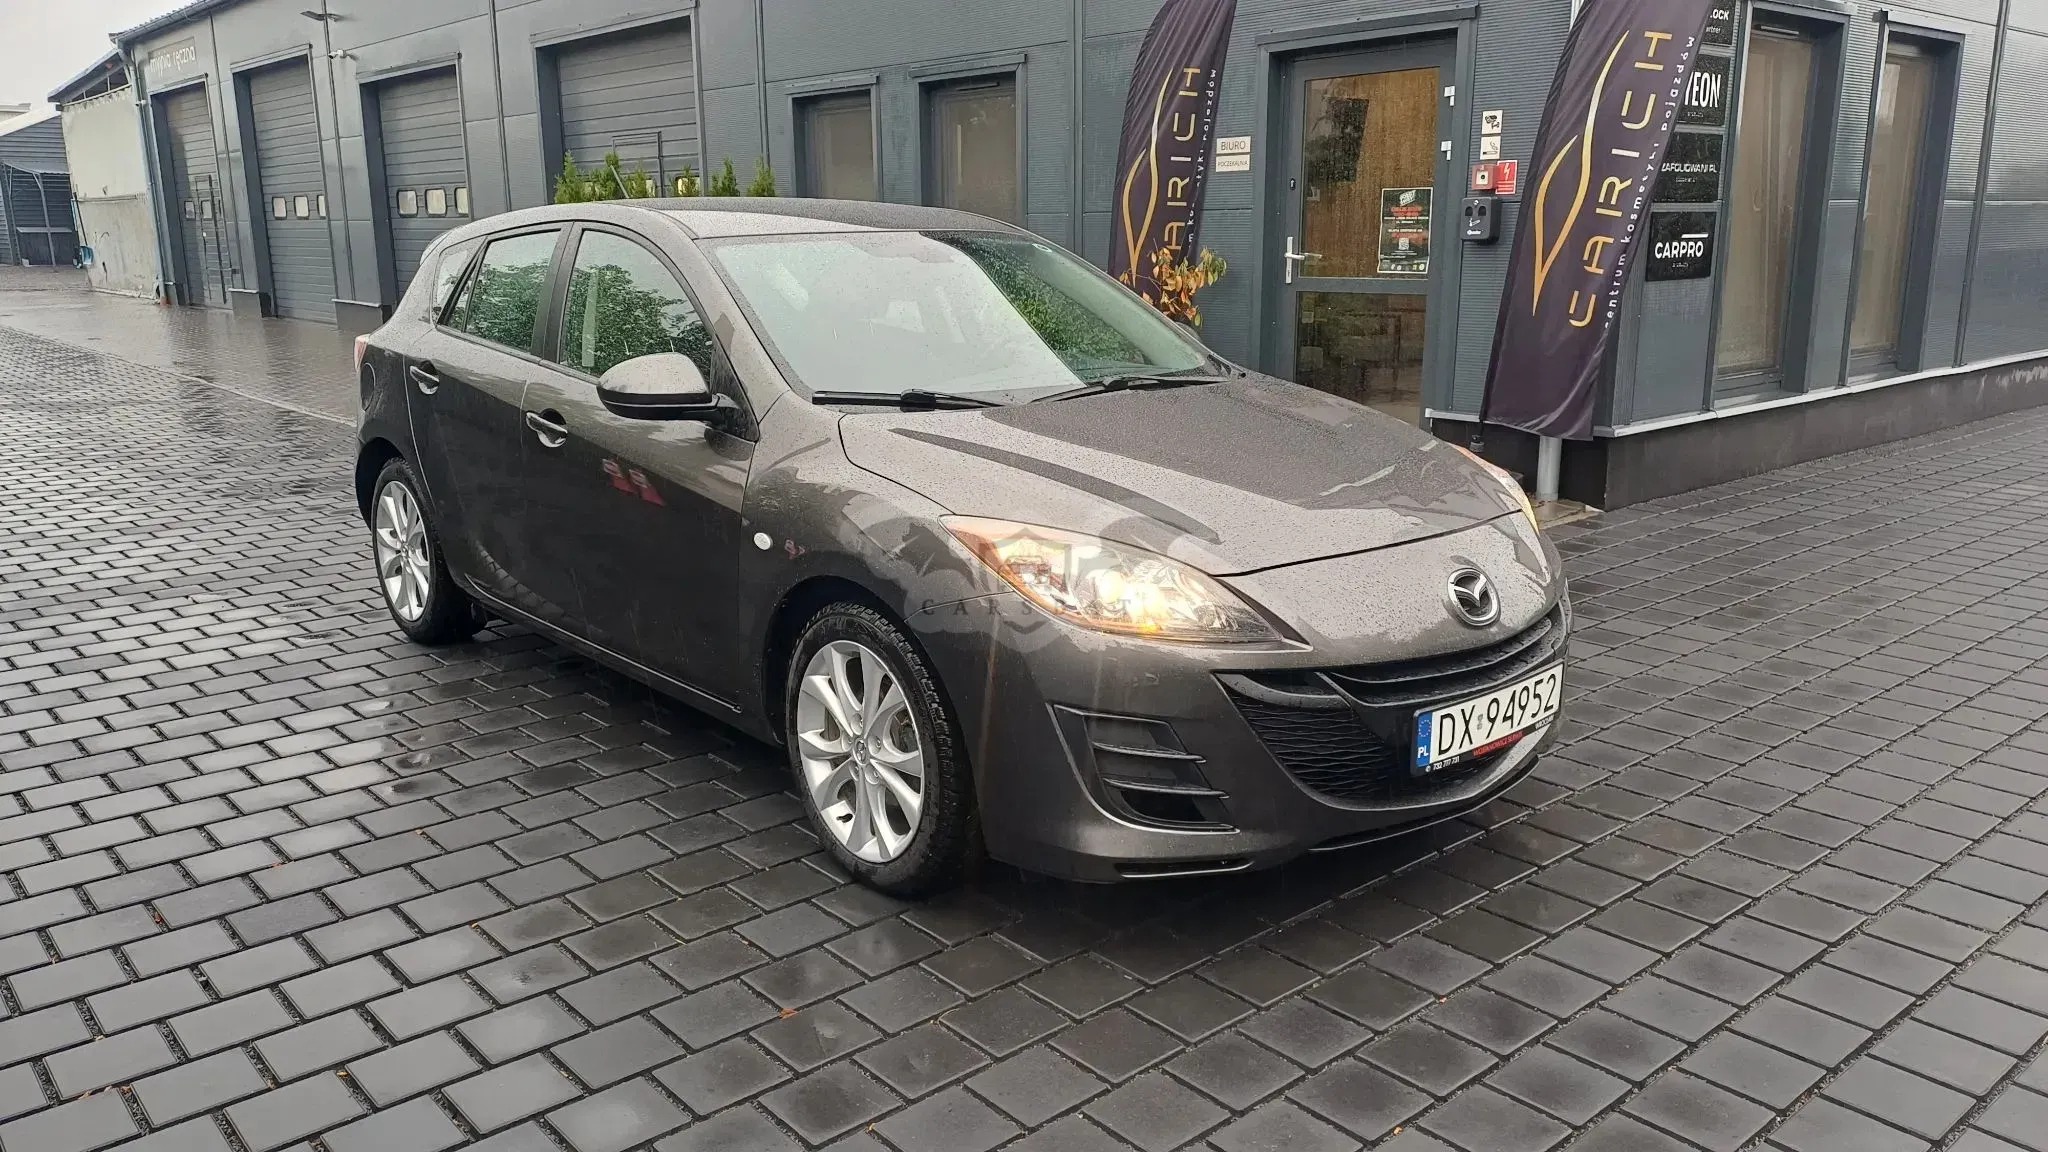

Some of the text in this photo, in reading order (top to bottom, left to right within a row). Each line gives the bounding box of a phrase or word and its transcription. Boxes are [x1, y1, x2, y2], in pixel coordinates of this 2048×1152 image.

[1709, 9, 1730, 20] OCK
[1220, 140, 1246, 151] BIURO
[1163, 67, 1201, 251] ARICH
[1654, 241, 1704, 259] CARPRO
[1438, 673, 1557, 756] DX 94952
[1417, 745, 1429, 759] PL
